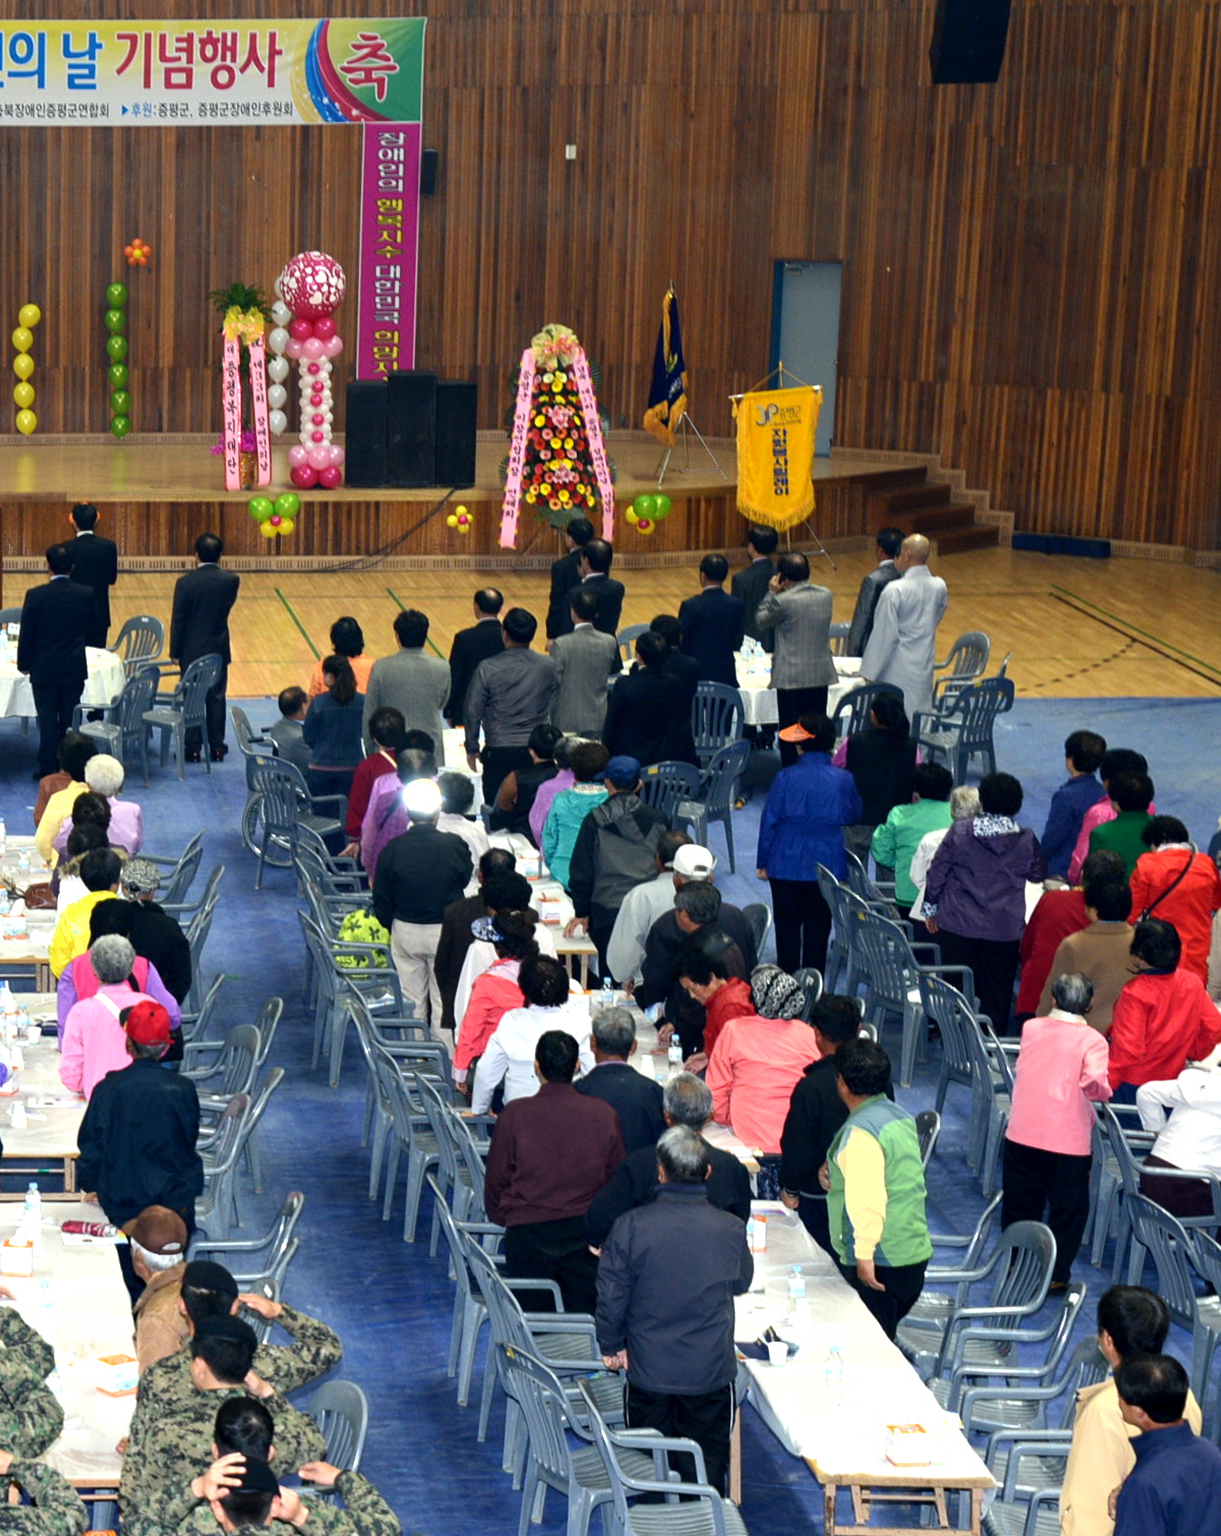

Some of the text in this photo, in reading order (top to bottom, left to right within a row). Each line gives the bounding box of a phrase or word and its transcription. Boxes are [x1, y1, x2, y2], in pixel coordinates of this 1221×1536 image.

[62, 31, 103, 90] 날
[115, 30, 283, 90] 기념행사
[337, 33, 399, 101] 축
[372, 131, 406, 382] 장애인의 행복지수 대한민국 희망지
